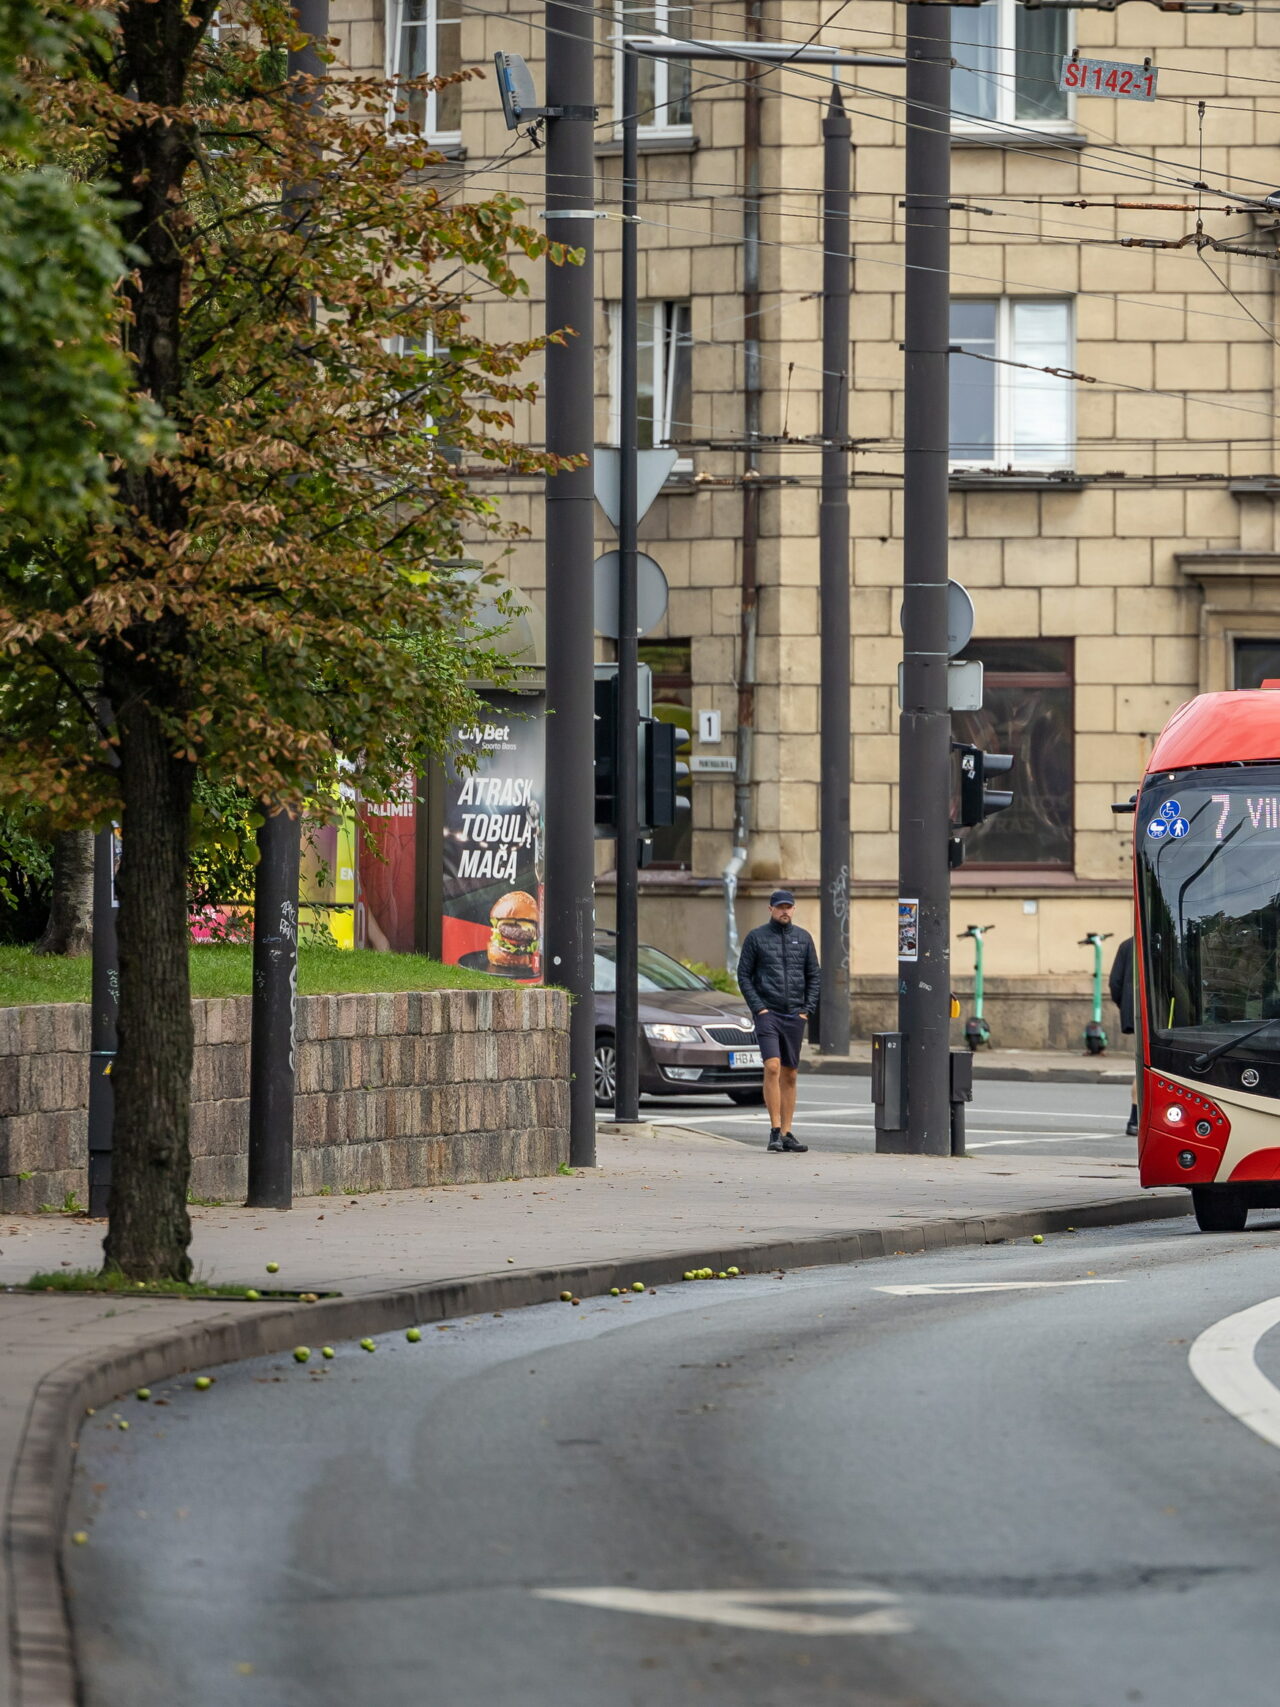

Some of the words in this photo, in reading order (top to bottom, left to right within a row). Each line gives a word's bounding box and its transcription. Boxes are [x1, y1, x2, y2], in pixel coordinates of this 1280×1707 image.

[706, 715, 712, 738] 1
[457, 777, 534, 807] ATRASK
[460, 813, 533, 849] TOBULĄ
[1211, 794, 1230, 839] 7
[457, 843, 518, 884] MAČĄ
